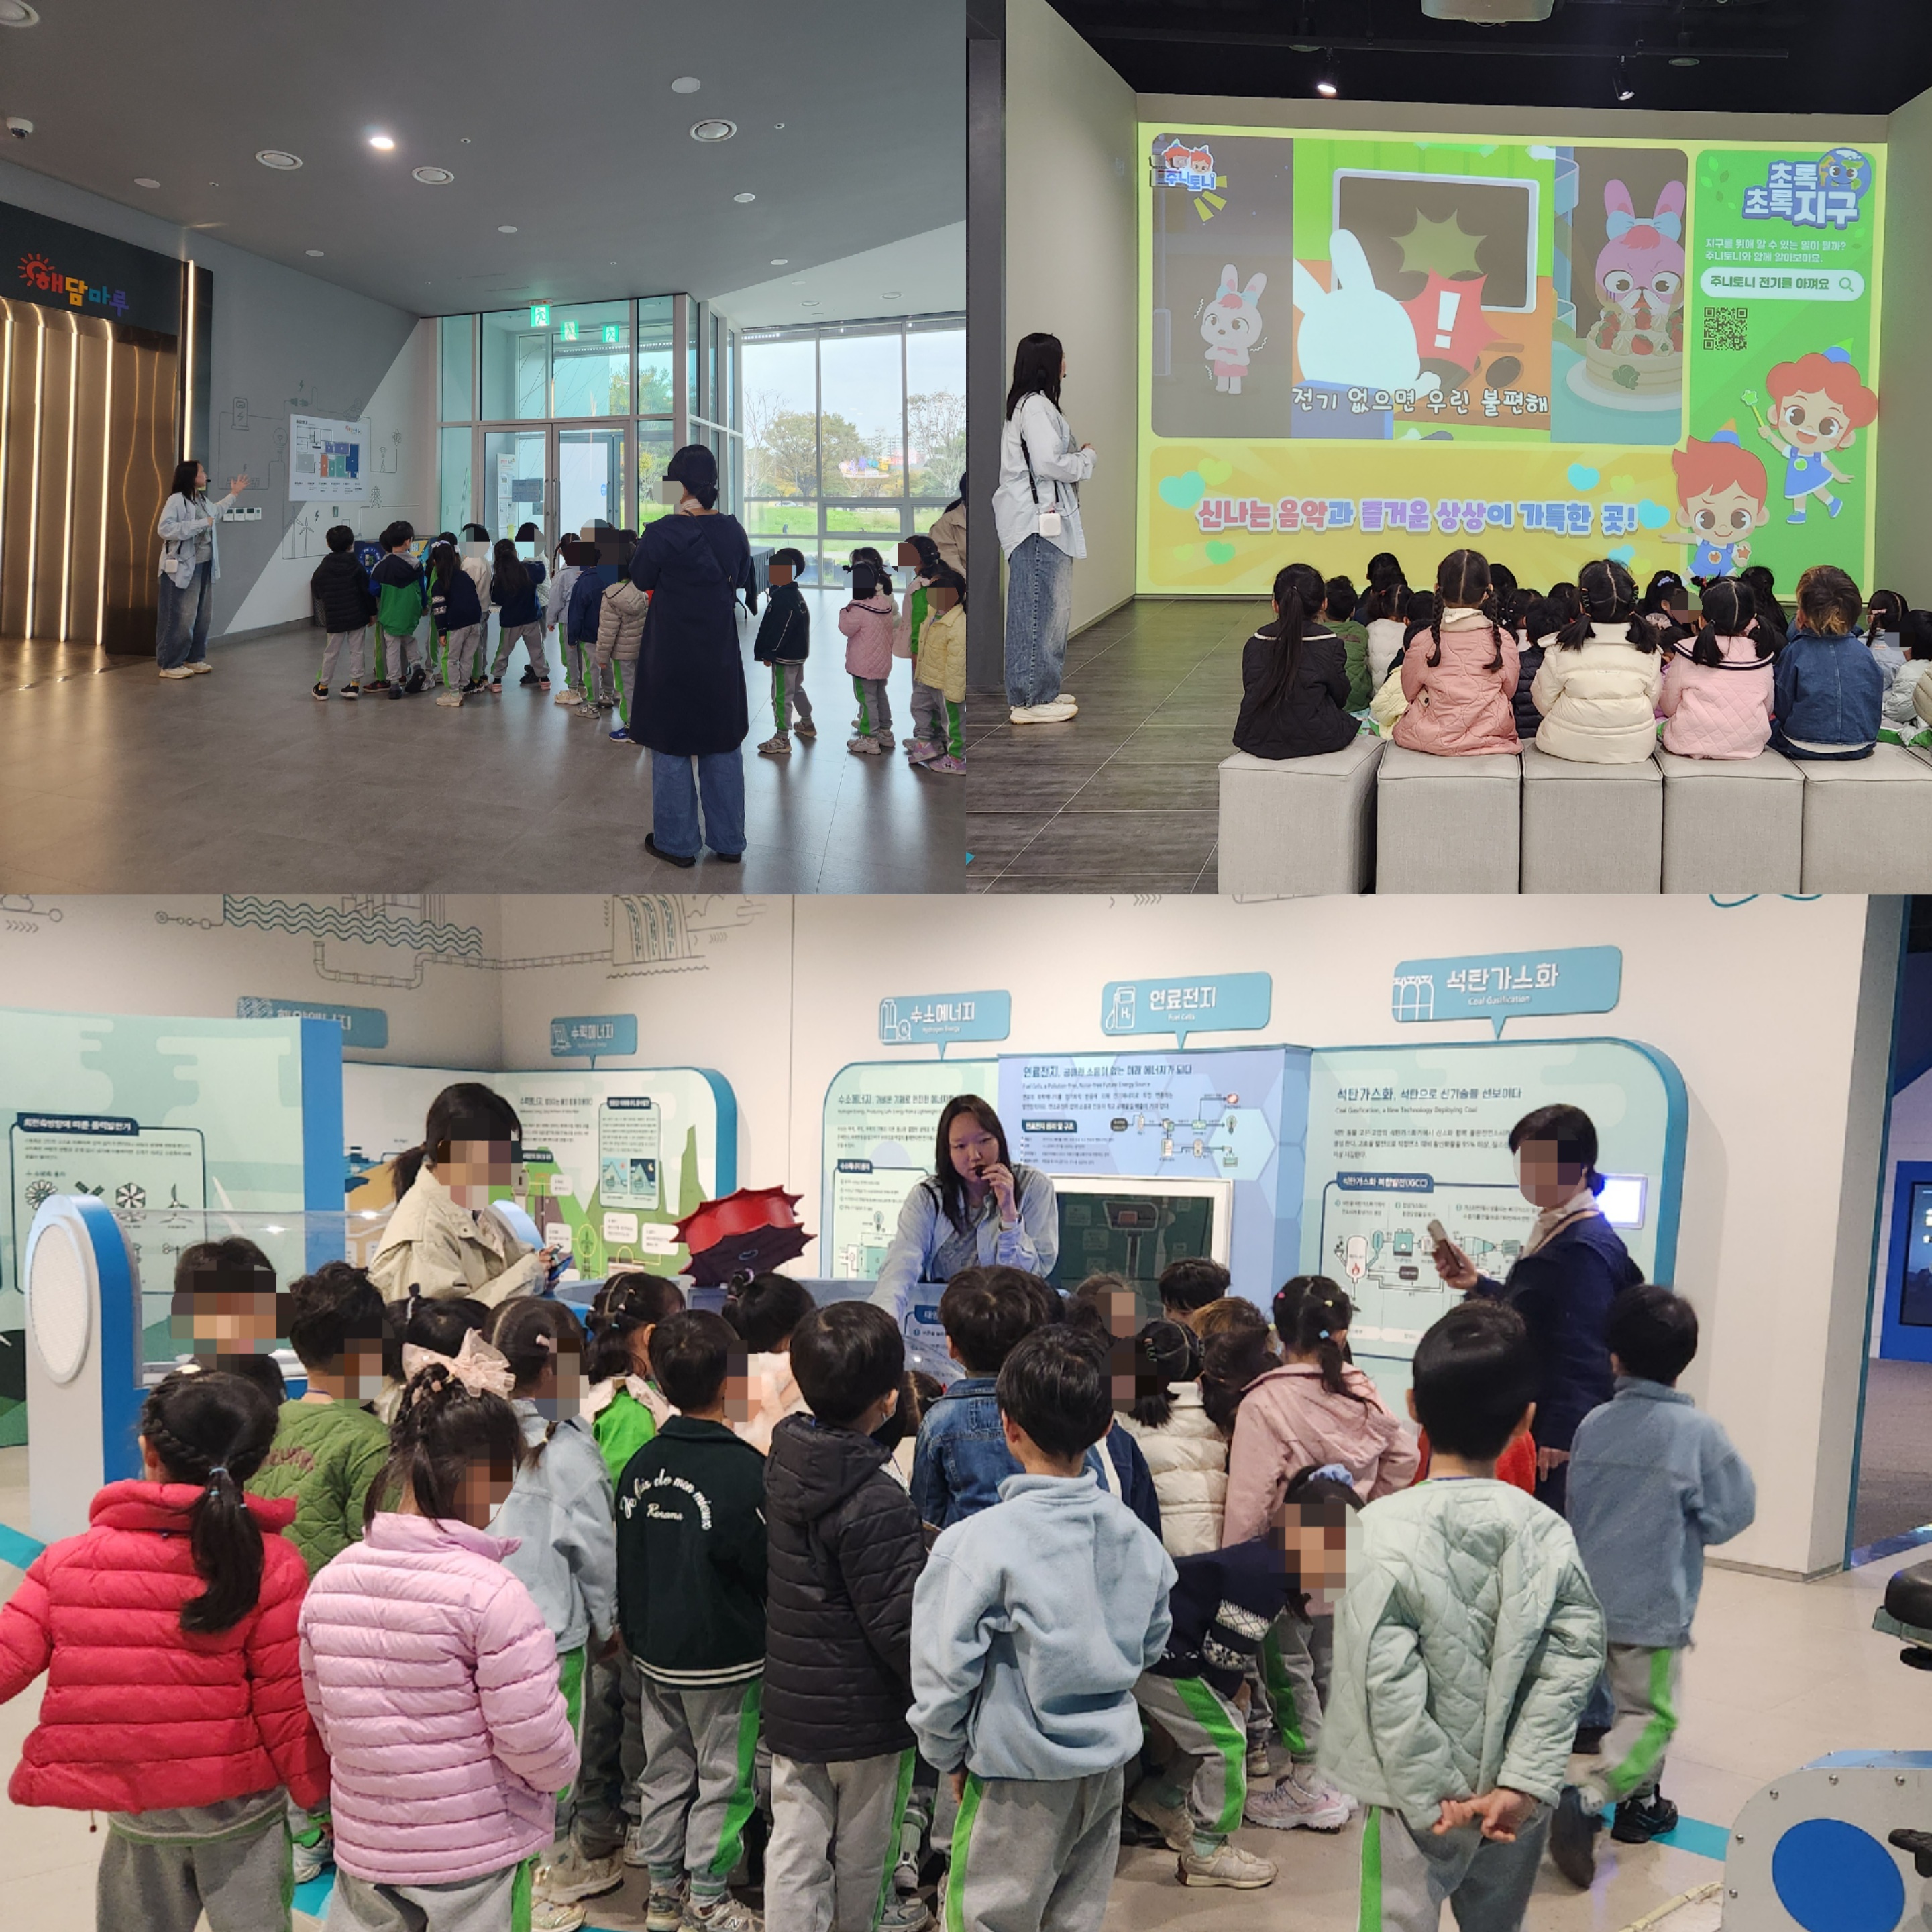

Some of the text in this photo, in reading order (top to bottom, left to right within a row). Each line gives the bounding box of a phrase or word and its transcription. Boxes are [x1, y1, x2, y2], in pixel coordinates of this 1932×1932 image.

[1166, 171, 1215, 191] 주니토니
[1768, 162, 1818, 190] 초록
[1705, 238, 1733, 249] 지구를
[1735, 239, 1754, 249] 위해
[1756, 239, 1766, 249] 할
[1768, 240, 1778, 249] 수
[1780, 240, 1799, 250] 있는
[1801, 241, 1819, 250] 일이
[1705, 251, 1752, 262] 주니토니와
[1754, 252, 1772, 262] 함께
[1711, 276, 1830, 290] 주니토니 전기를 아껴요
[35, 270, 129, 317] 해담마루
[1292, 388, 1550, 417] 전기 없으면 우린 불편해
[1198, 499, 1635, 533] 신나는 음악과 즐거운 상상이 가득한 곳!
[1446, 963, 1559, 993] 석탄가스화
[1150, 986, 1216, 1011] 연료전지
[1468, 995, 1531, 1005] Coal Gasification
[910, 1002, 975, 1023] 수소에너지
[1338, 1087, 1522, 1101] 석탄가스화, 석탄으로 신기술을 선보이다
[1401, 1106, 1433, 1114] Technology
